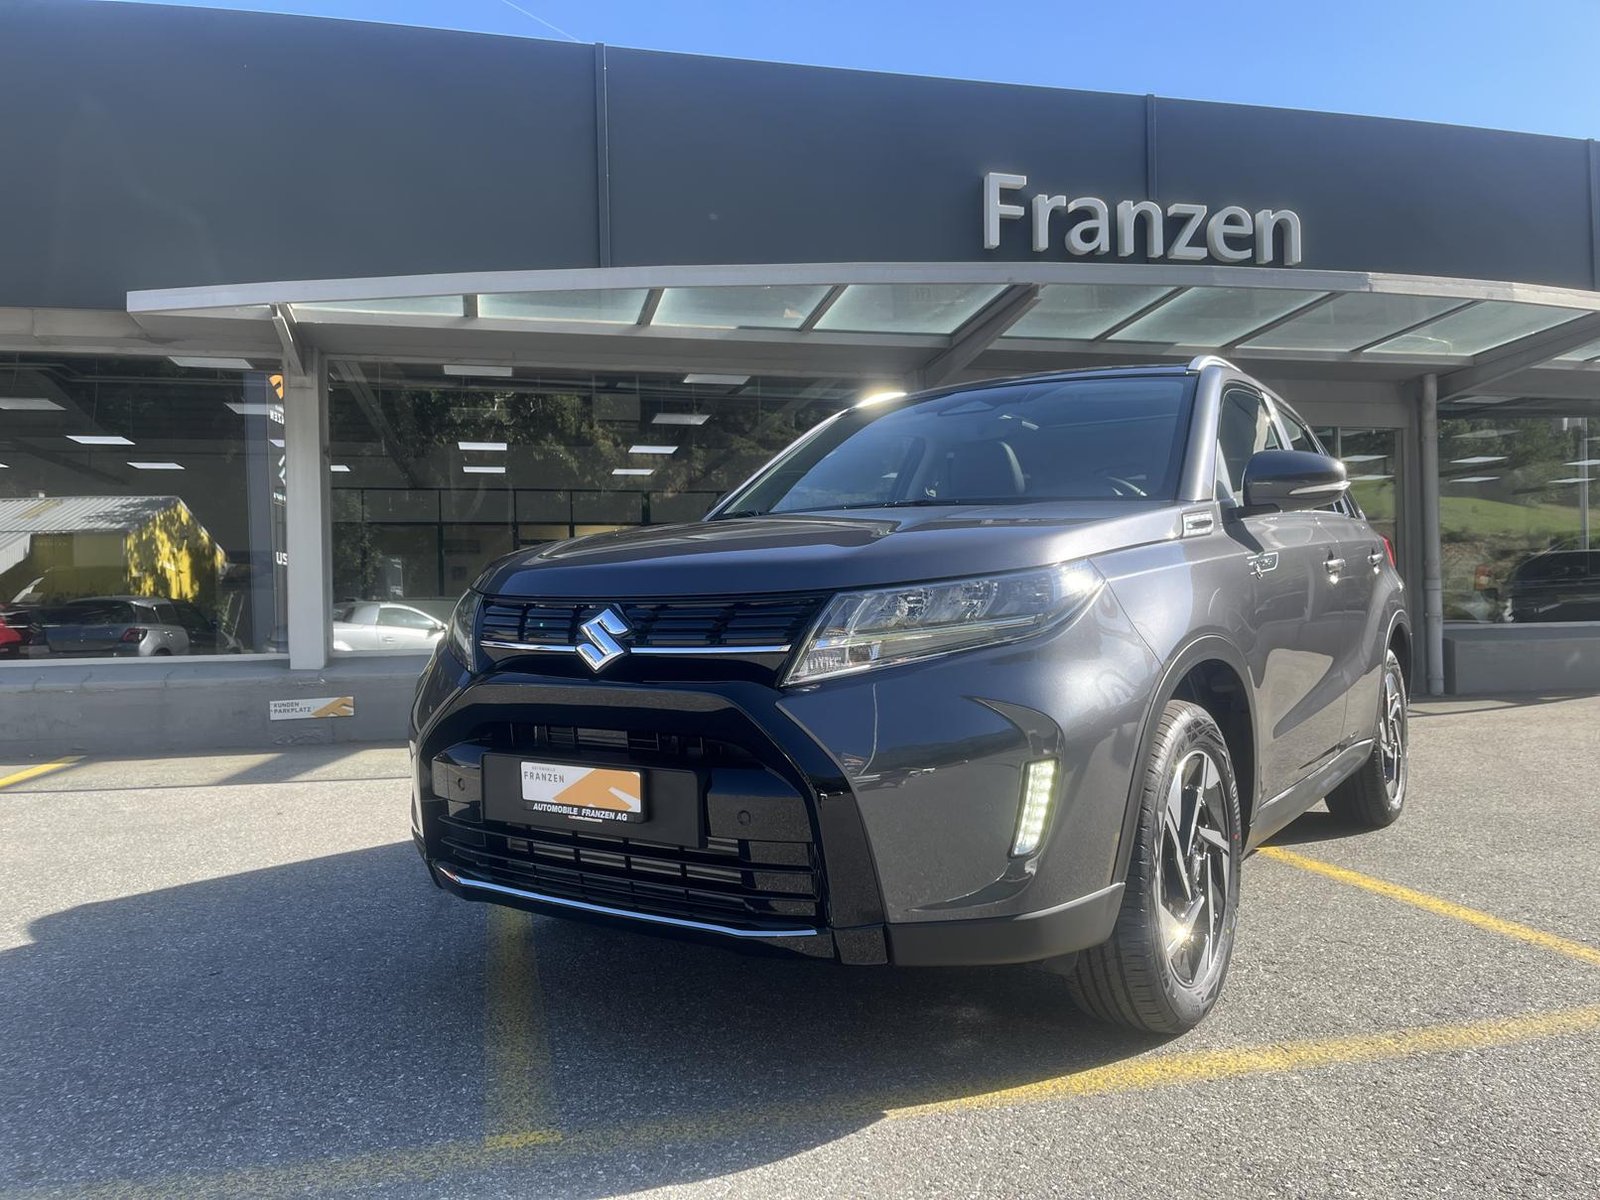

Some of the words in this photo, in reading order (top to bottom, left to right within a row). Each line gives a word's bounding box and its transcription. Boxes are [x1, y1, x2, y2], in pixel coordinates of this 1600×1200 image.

[983, 172, 1302, 266] Franzen
[524, 771, 565, 783] FRANZEN
[533, 803, 578, 815] AUTOMOBILE
[581, 808, 615, 820] FRANZEN
[616, 813, 628, 821] AG
